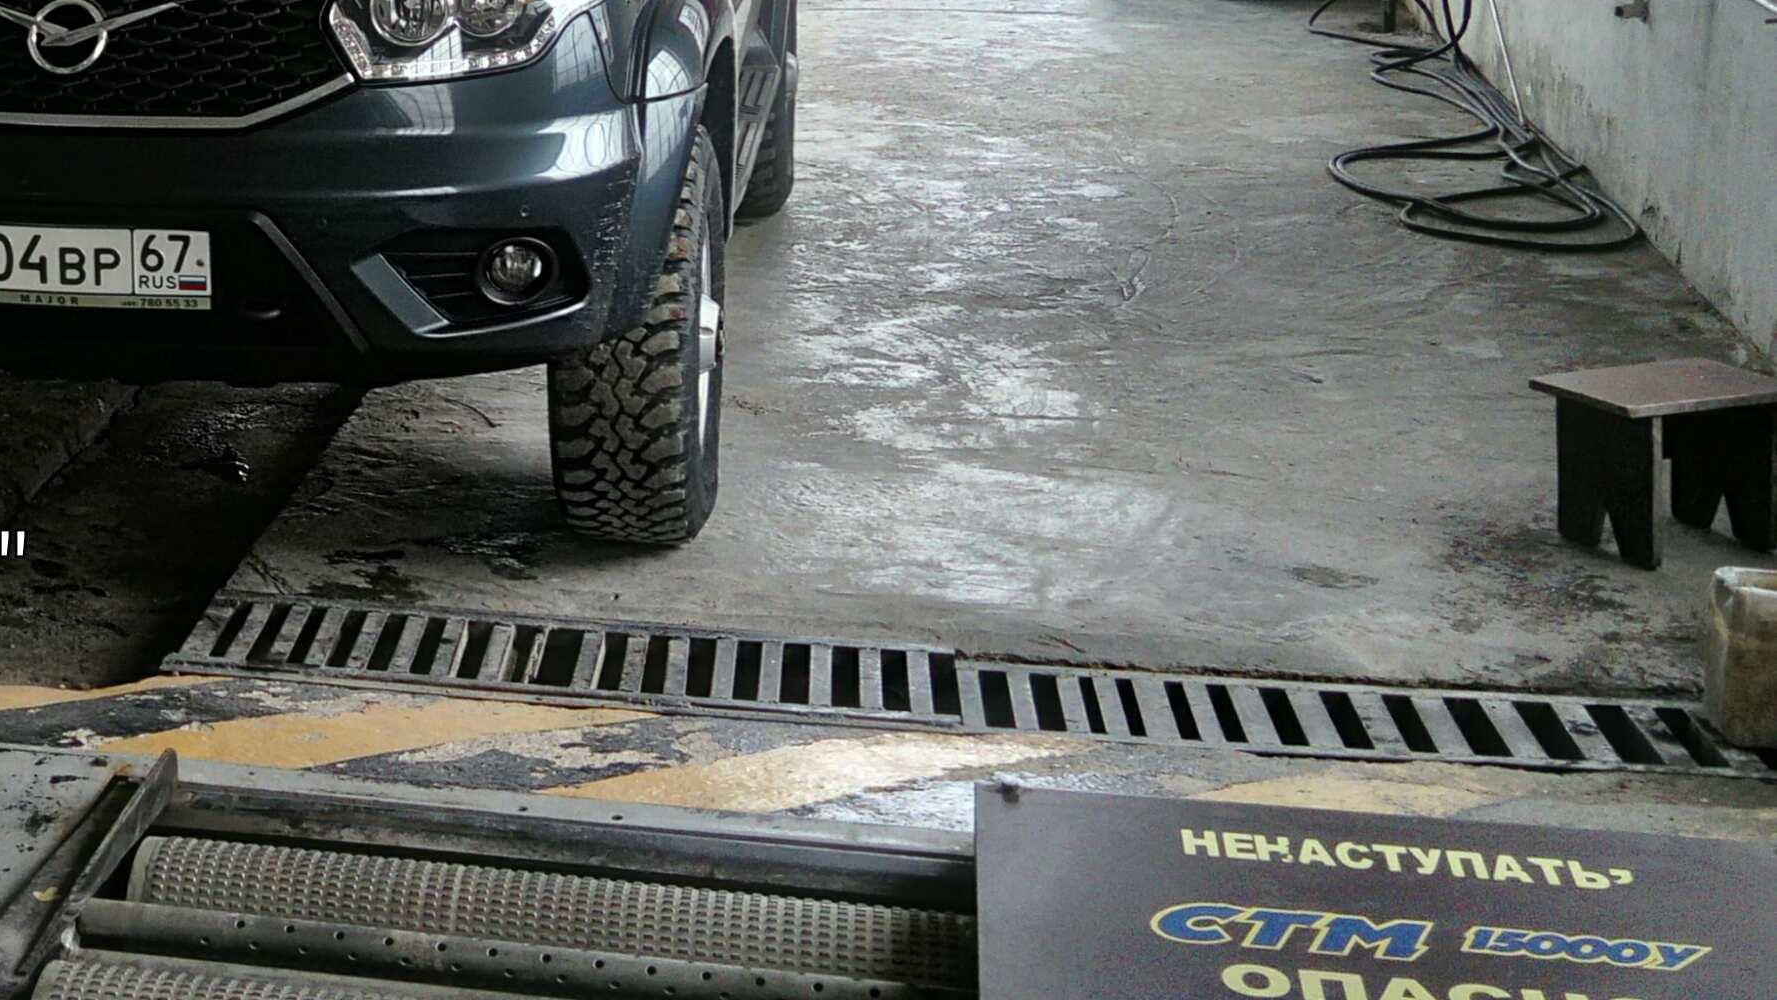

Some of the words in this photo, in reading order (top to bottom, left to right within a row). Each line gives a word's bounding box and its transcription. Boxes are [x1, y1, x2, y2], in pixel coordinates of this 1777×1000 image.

[140, 234, 191, 273] 67
[138, 274, 178, 289] RUS
[1150, 902, 1434, 962] СТМ
